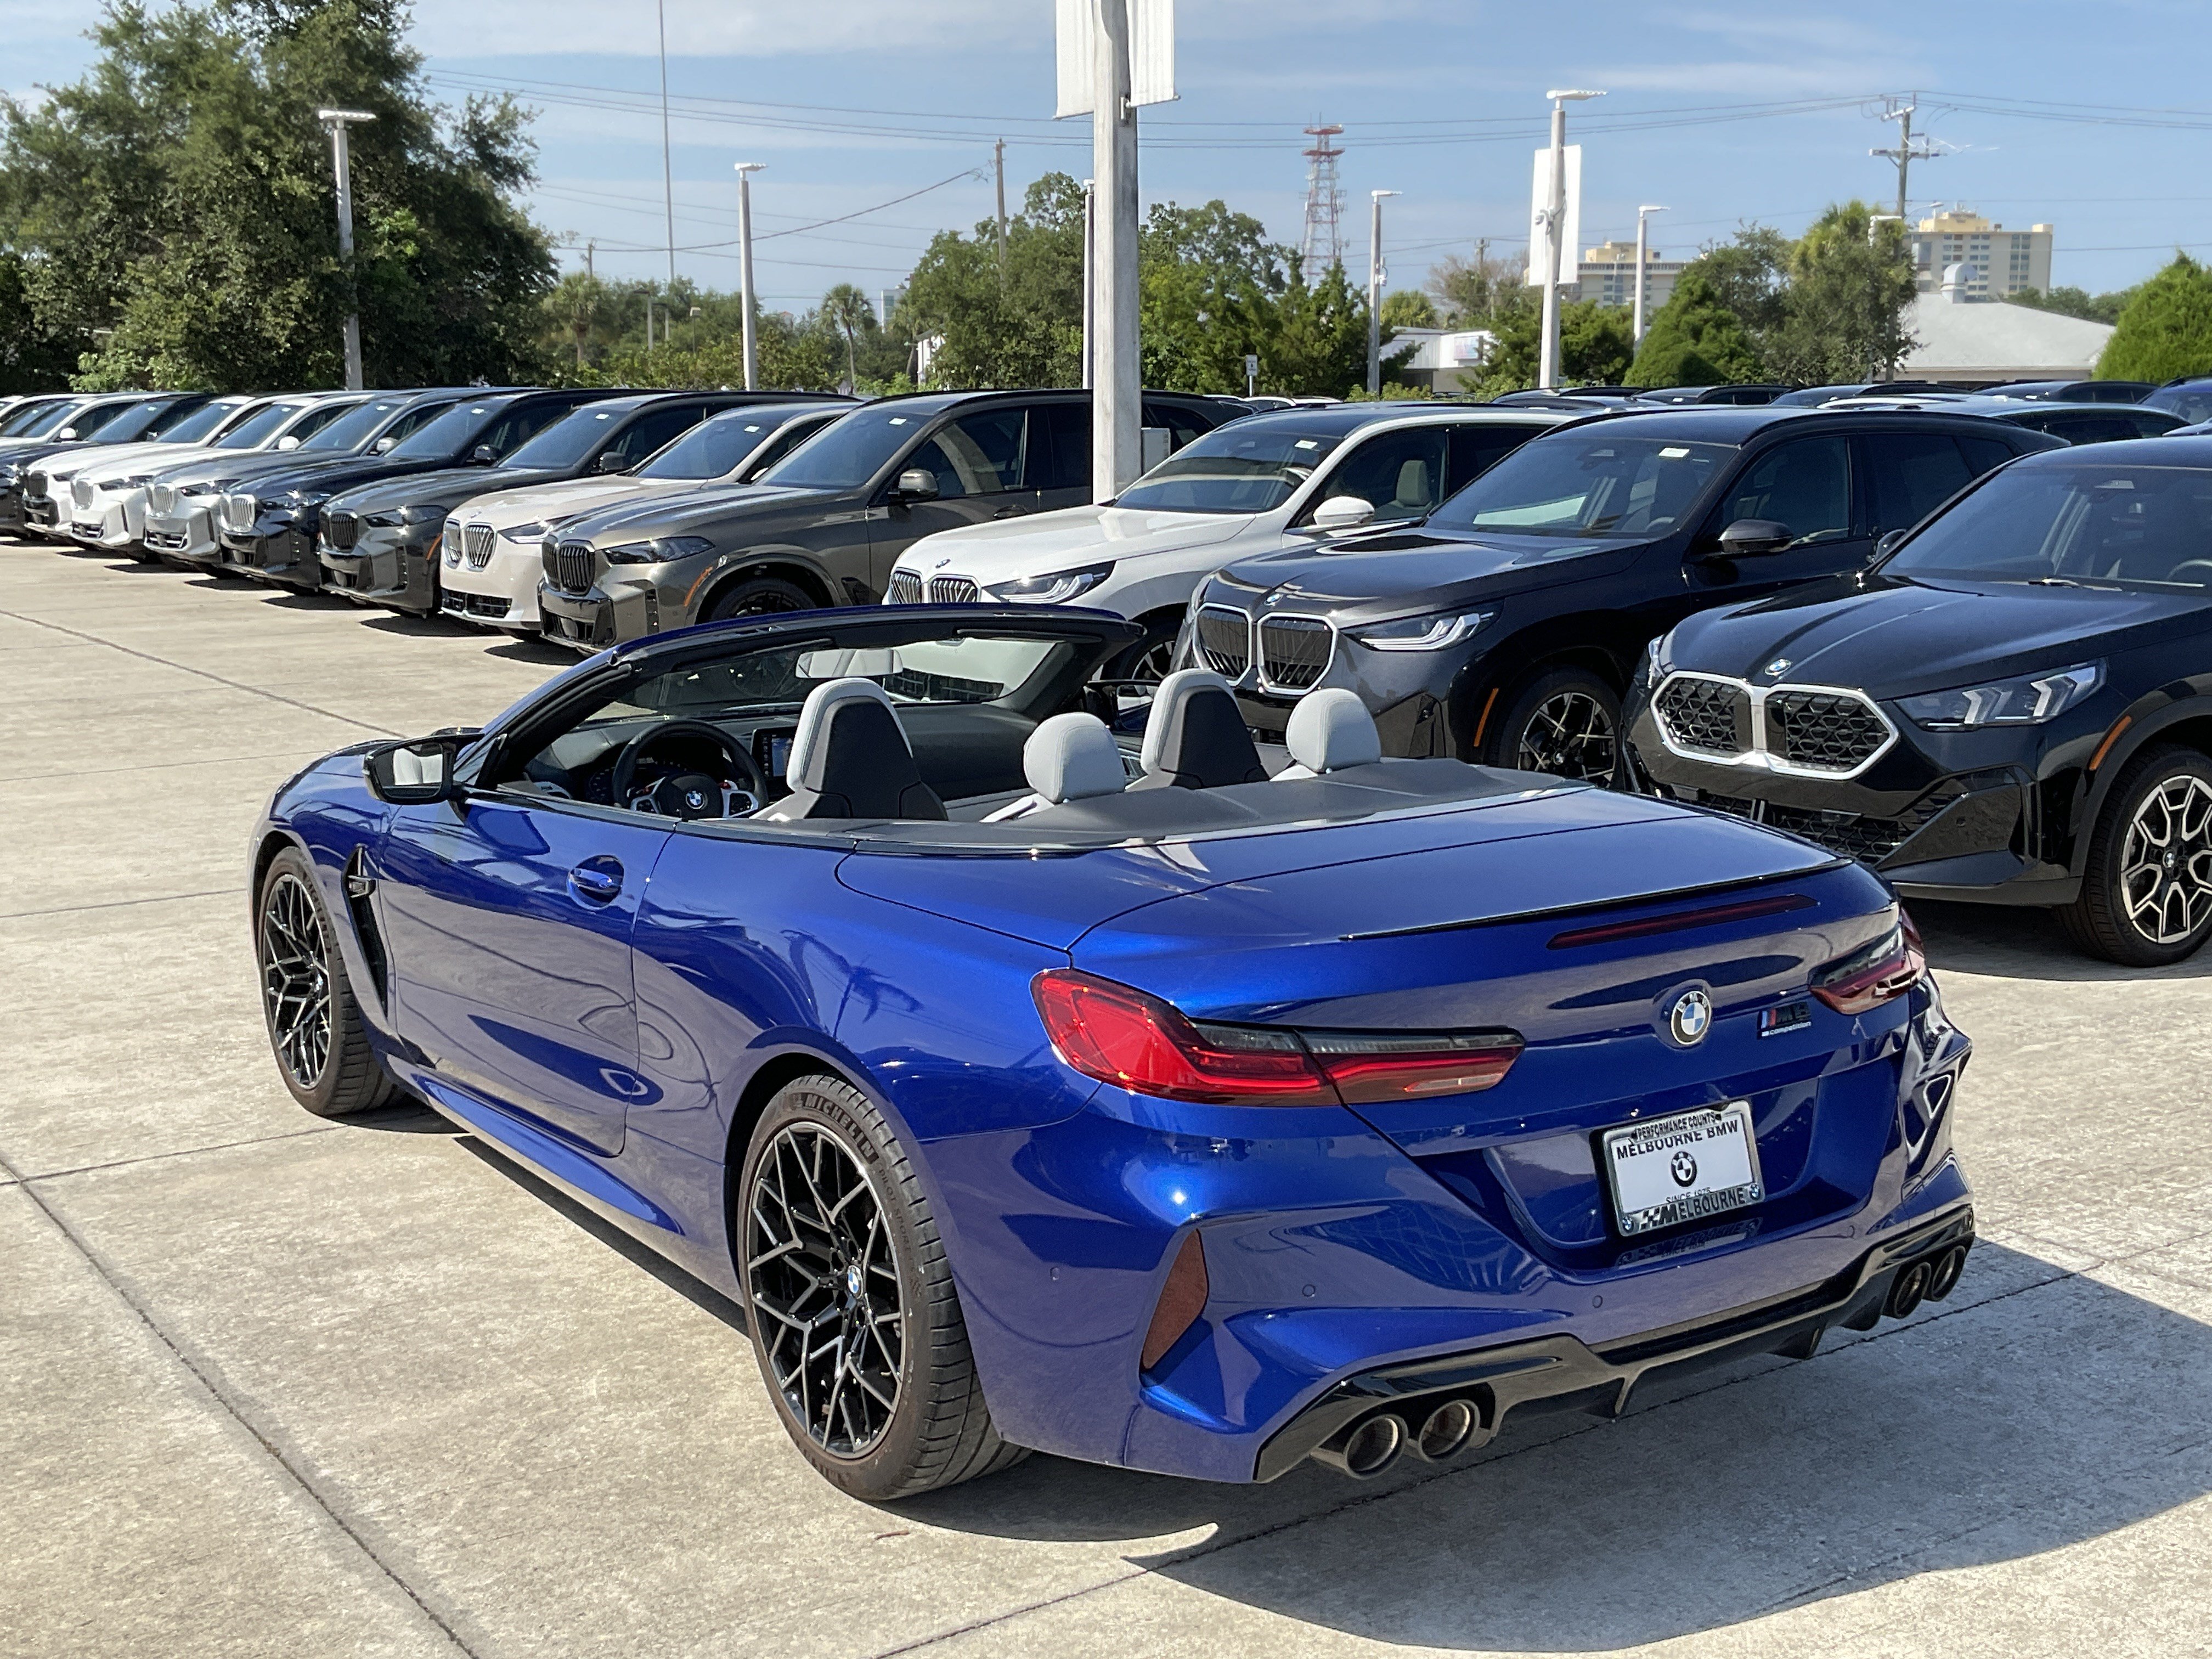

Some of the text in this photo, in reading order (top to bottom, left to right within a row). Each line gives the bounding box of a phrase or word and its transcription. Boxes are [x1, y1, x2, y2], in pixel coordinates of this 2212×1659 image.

[805, 1093, 877, 1161] MICHELIN
[1616, 1120, 1739, 1160] MELBOURNE BMW
[1637, 1111, 1716, 1141] PERFORMANCE COUNTS
[1657, 1187, 1746, 1224] MELBOURNE
